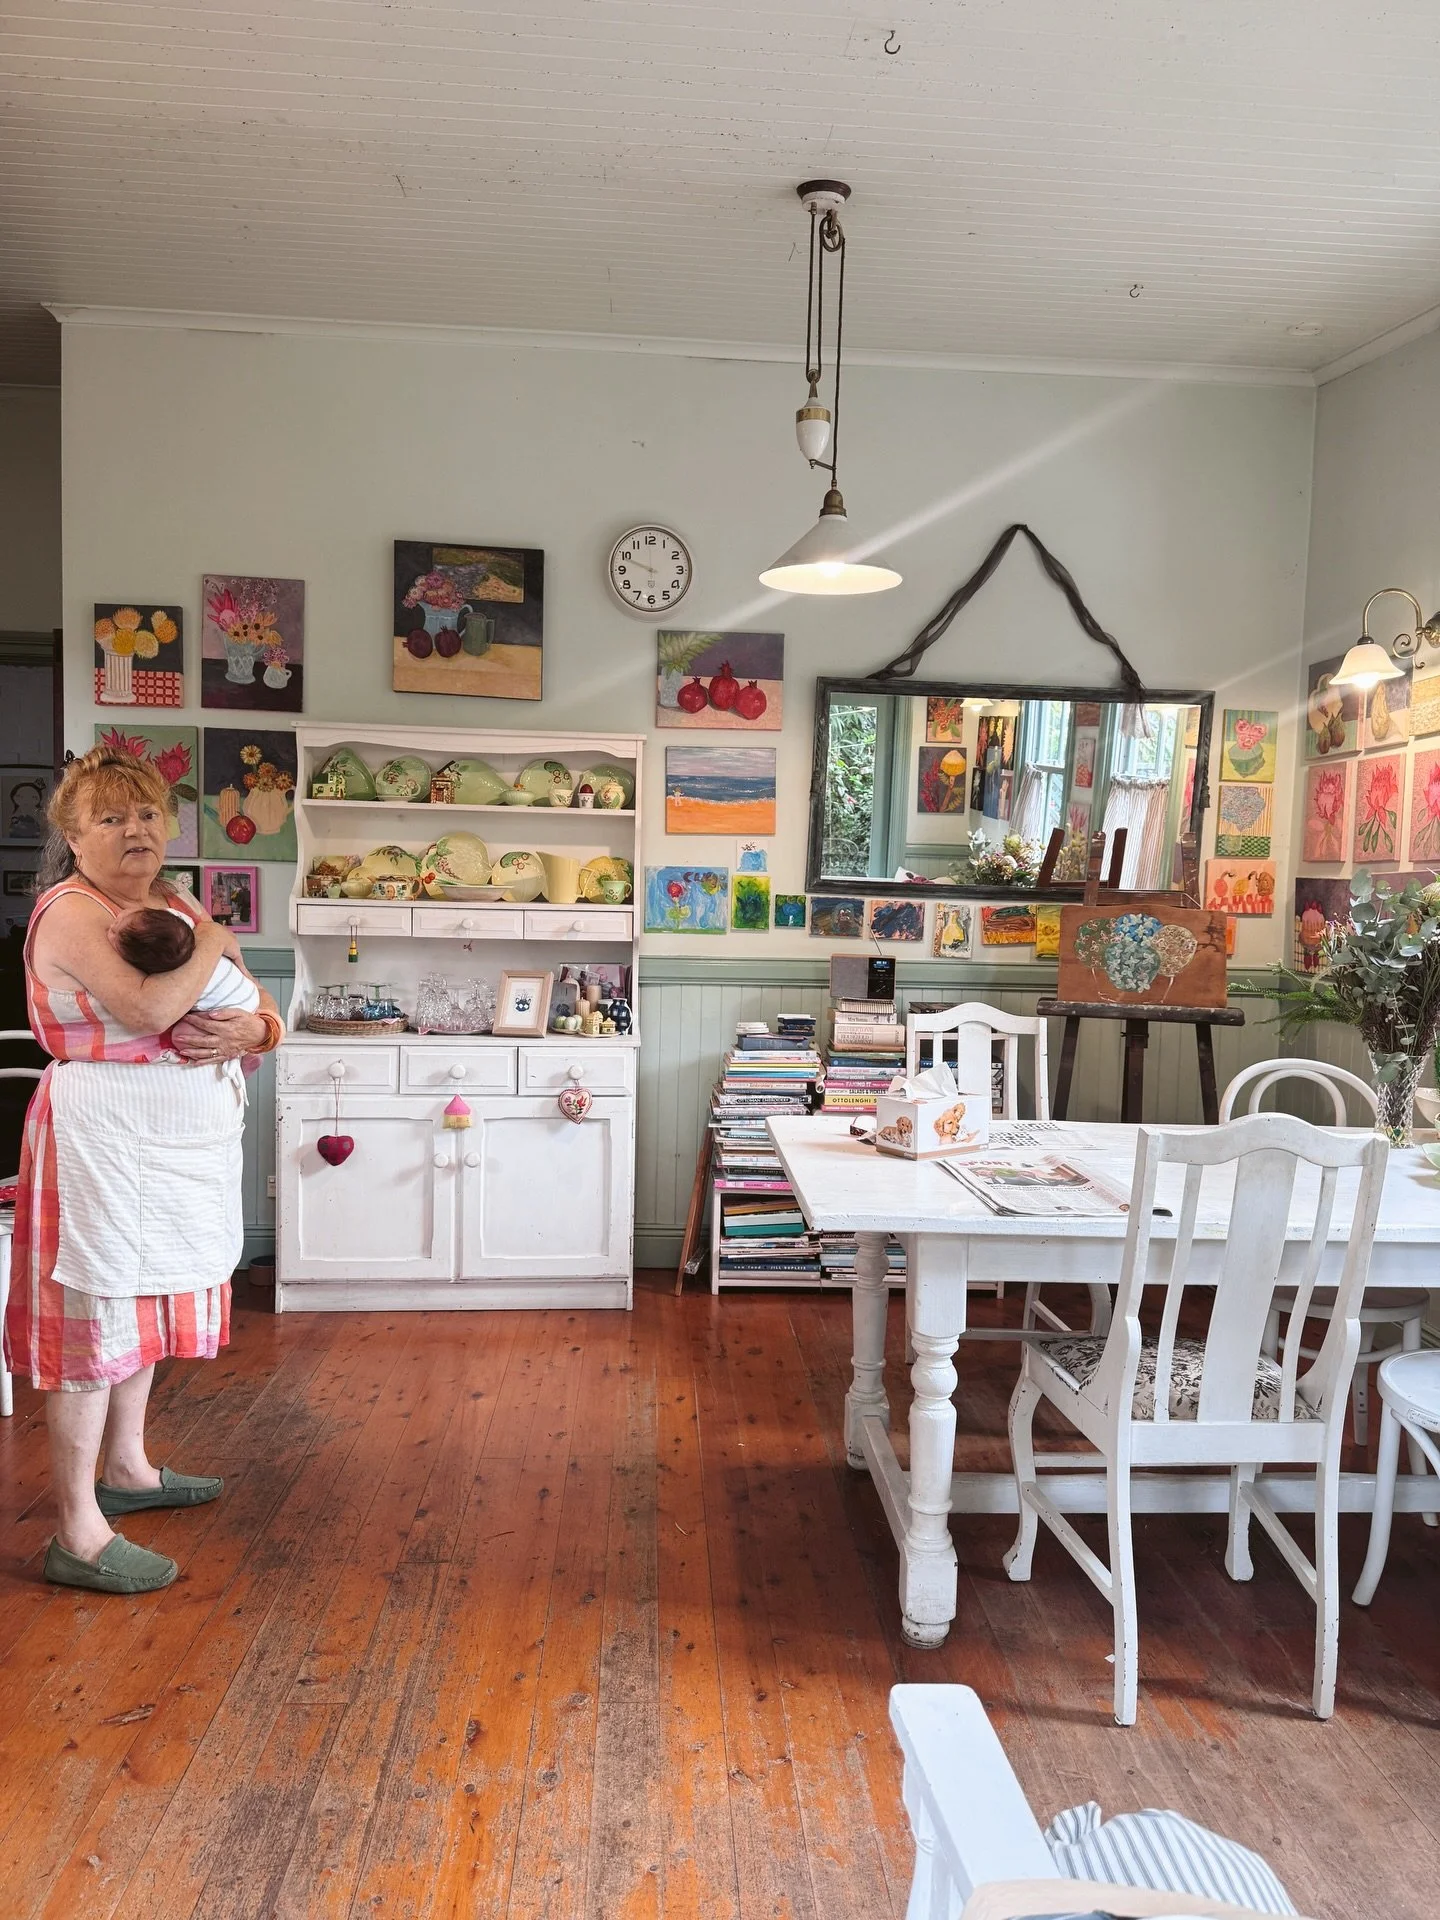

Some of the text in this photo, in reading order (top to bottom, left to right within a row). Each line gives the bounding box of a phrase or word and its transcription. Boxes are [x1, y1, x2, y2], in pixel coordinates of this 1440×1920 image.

[645, 535, 656, 545] 12
[633, 541, 640, 550] 11
[622, 551, 632, 560] 10
[672, 551, 680, 560] 2
[618, 565, 627, 575] 9
[676, 565, 684, 575] 3
[623, 580, 631, 589] 8
[671, 579, 681, 590] 4
[633, 590, 642, 600] 7
[647, 595, 656, 604] 6
[662, 590, 671, 600] 5
